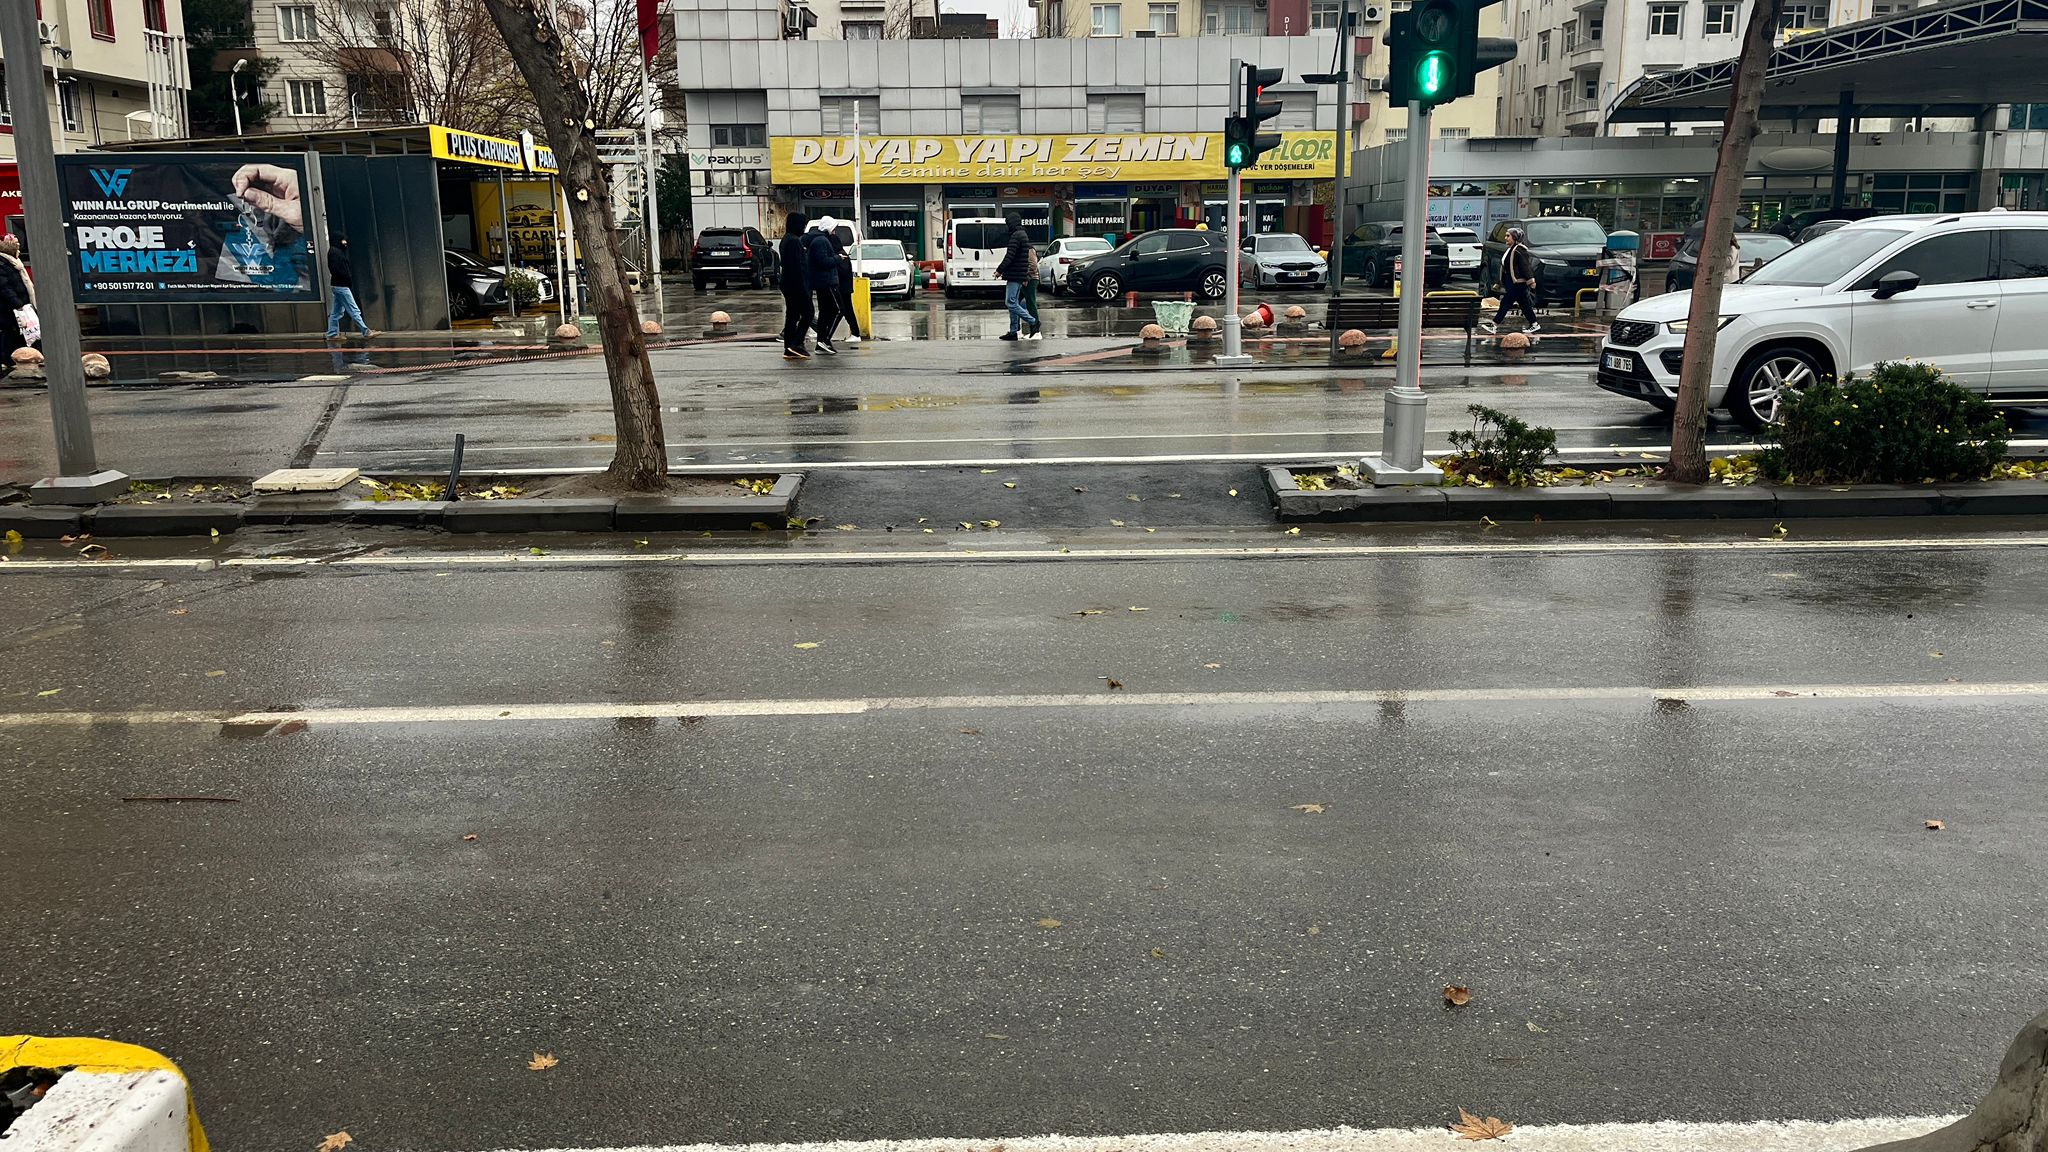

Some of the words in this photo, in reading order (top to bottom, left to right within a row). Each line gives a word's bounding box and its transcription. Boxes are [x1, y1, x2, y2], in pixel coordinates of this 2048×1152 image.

[451, 133, 477, 156] PLUS
[477, 138, 520, 164] CARWASH
[792, 138, 943, 166] DUYAP
[953, 137, 1053, 163] YAPI
[879, 164, 971, 178] Zemine
[976, 161, 1027, 177] dair
[1031, 162, 1073, 177] her
[1078, 165, 1122, 179] şey
[1135, 184, 1174, 193] DUYAP
[72, 200, 105, 211] WINN
[105, 200, 127, 211] ALL
[126, 200, 160, 211] GRUP
[161, 201, 222, 212] Gayrimenkul
[223, 202, 234, 211] ile
[120, 213, 147, 221] kazanç
[1021, 216, 1050, 226] ERDELERİ
[1077, 215, 1104, 224] LAMİNAT
[892, 219, 916, 227] DOLABI
[76, 225, 166, 250] PROJE
[93, 282, 108, 290] +90
[108, 282, 122, 290] 501
[122, 282, 135, 290] 517
[135, 282, 145, 290] 72
[145, 282, 154, 290] 01
